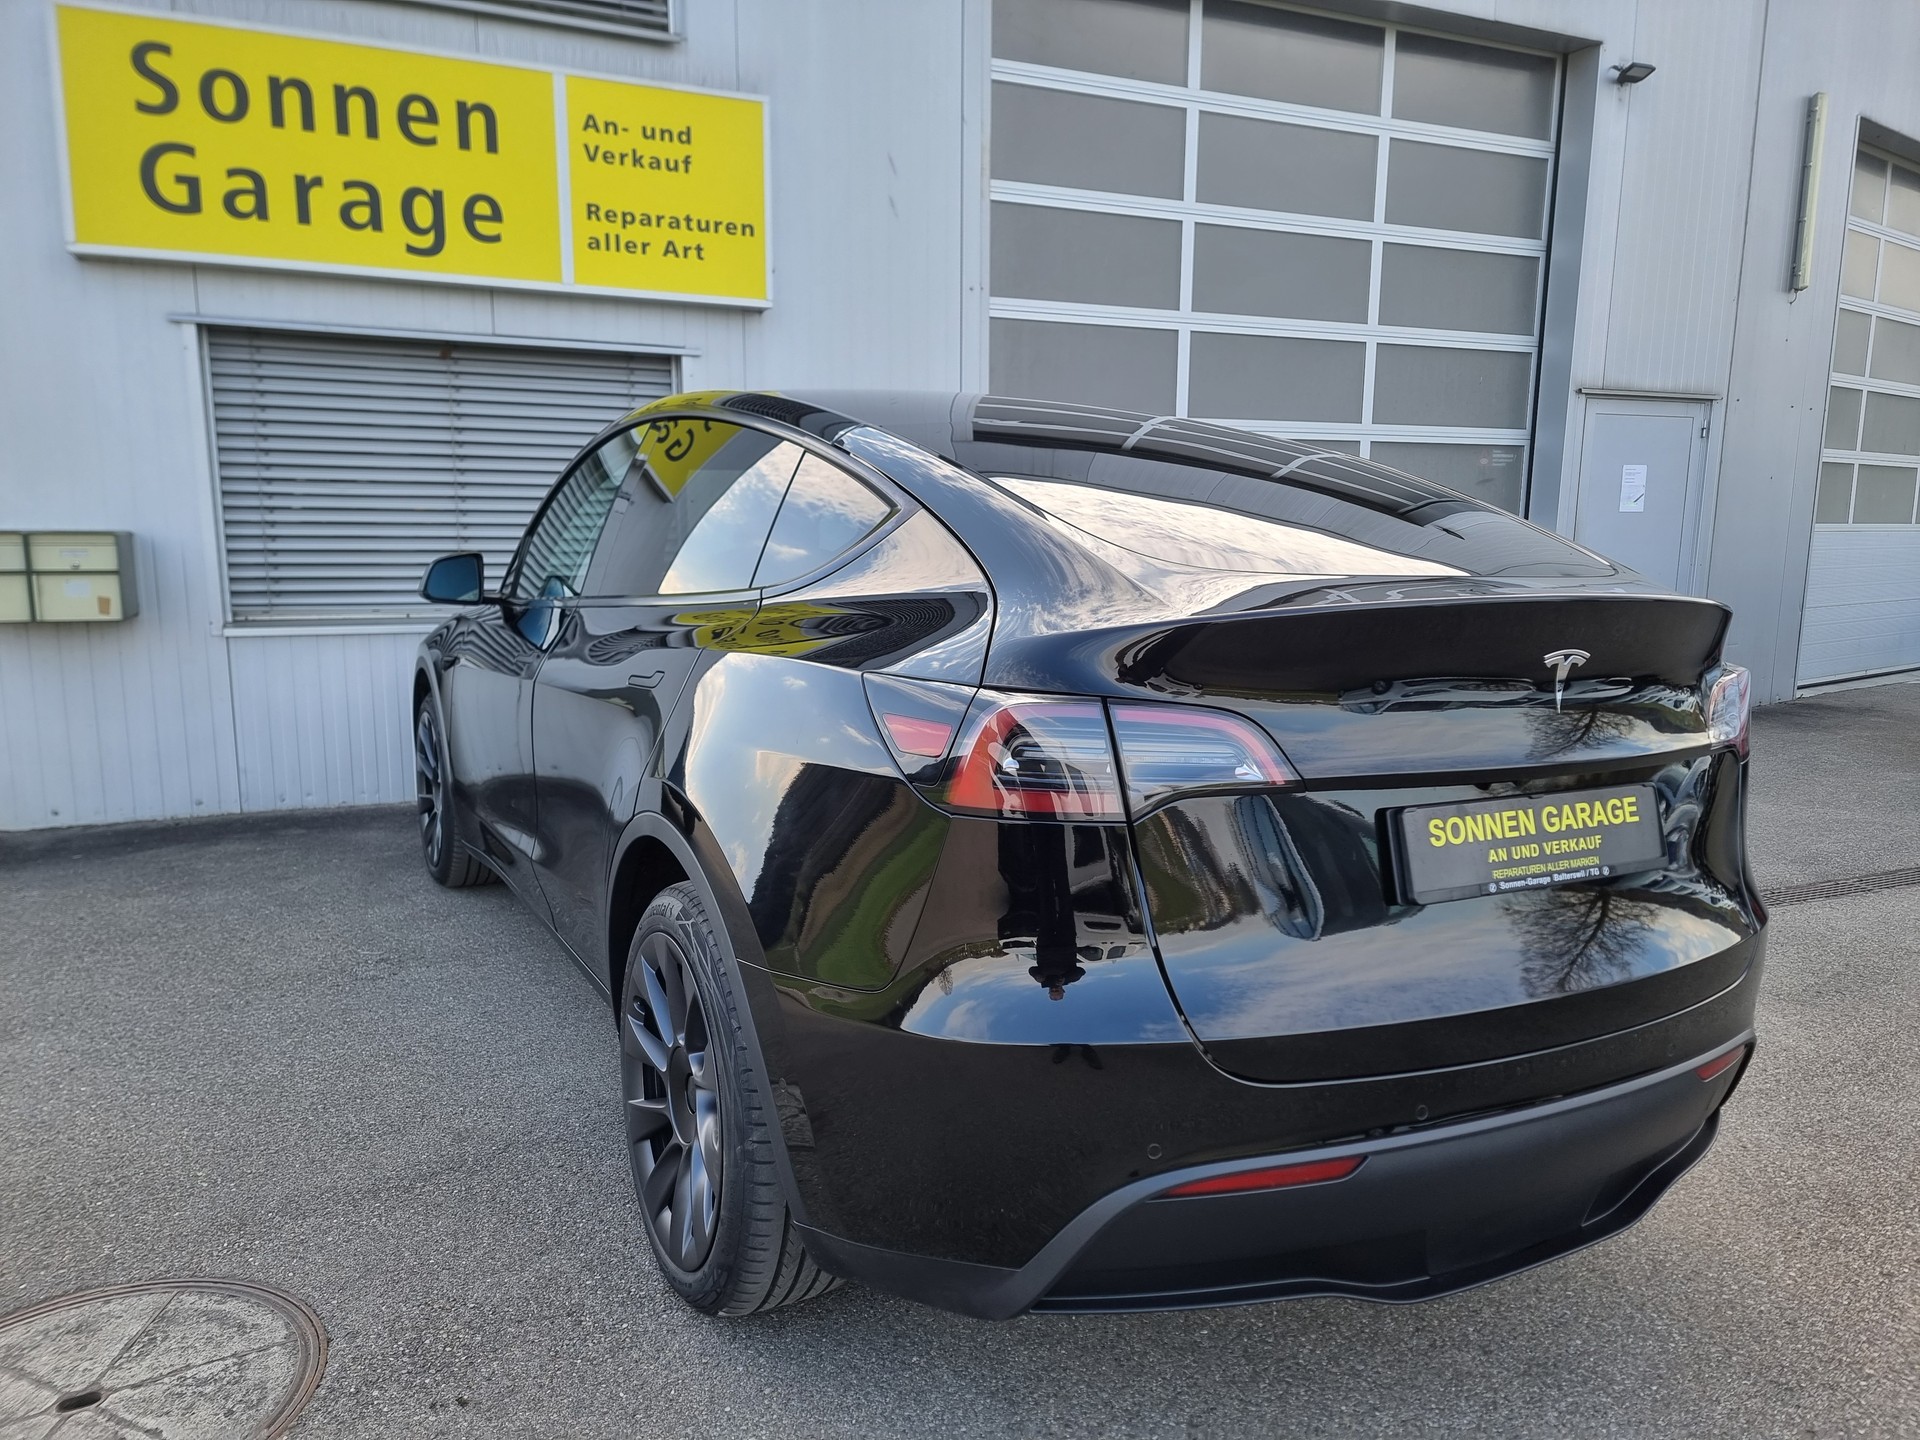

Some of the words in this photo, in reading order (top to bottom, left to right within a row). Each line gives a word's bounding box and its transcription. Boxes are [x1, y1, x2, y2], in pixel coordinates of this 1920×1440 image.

[129, 40, 500, 155] Sonnen
[583, 114, 629, 136] An-
[641, 126, 692, 145] und
[584, 143, 692, 174] Verkauf
[138, 141, 505, 258] Garage
[586, 203, 756, 237] Reparaturen
[587, 233, 650, 255] aller
[663, 240, 705, 261] Art
[1428, 808, 1537, 848] SONNEN
[1541, 796, 1640, 833] GARAGE
[1488, 847, 1508, 863] AN
[1511, 843, 1540, 860] UND
[1542, 835, 1602, 855] VERKAUF
[1492, 864, 1547, 879] REPARATUREN
[1547, 860, 1570, 871] ALLER
[1570, 856, 1599, 868] MARKEN
